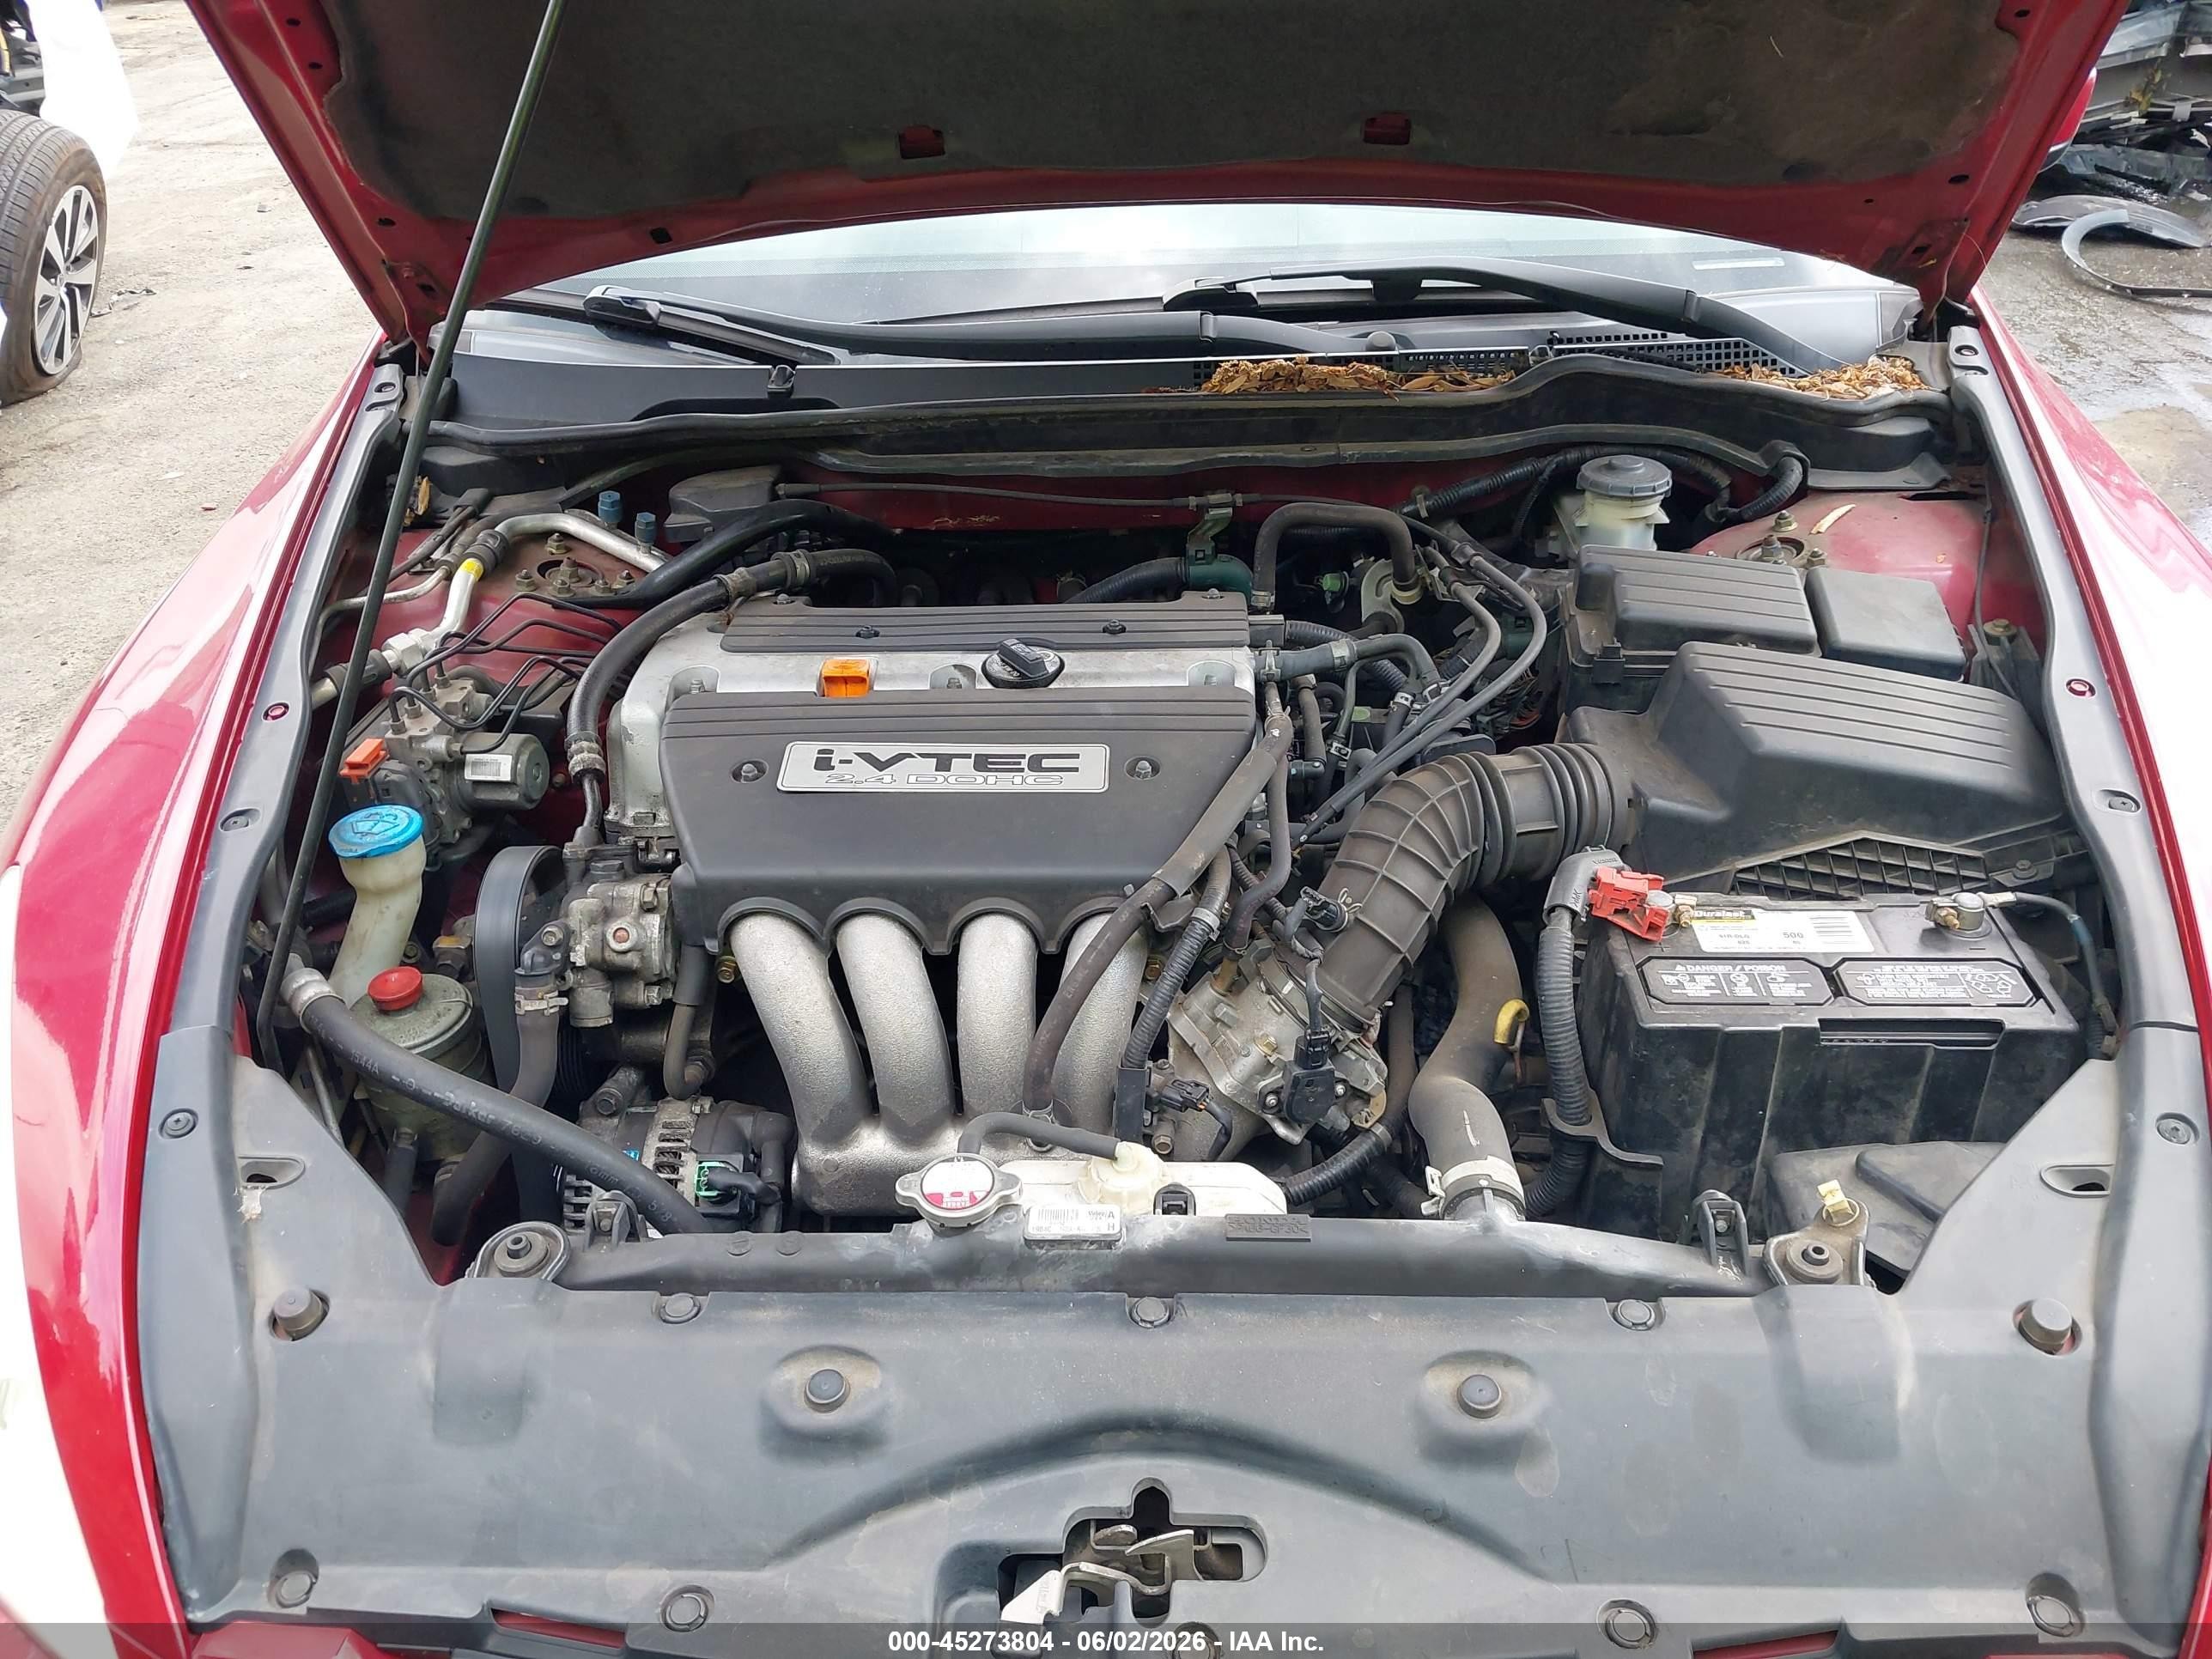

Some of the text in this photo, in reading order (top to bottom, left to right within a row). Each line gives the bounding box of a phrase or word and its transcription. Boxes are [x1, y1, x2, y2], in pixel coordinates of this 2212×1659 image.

[813, 748, 1080, 773] i-VTEC
[825, 773, 1064, 786] 2.4 DOHC
[1108, 1211, 1115, 1219] A
[1108, 1222, 1115, 1231] H
